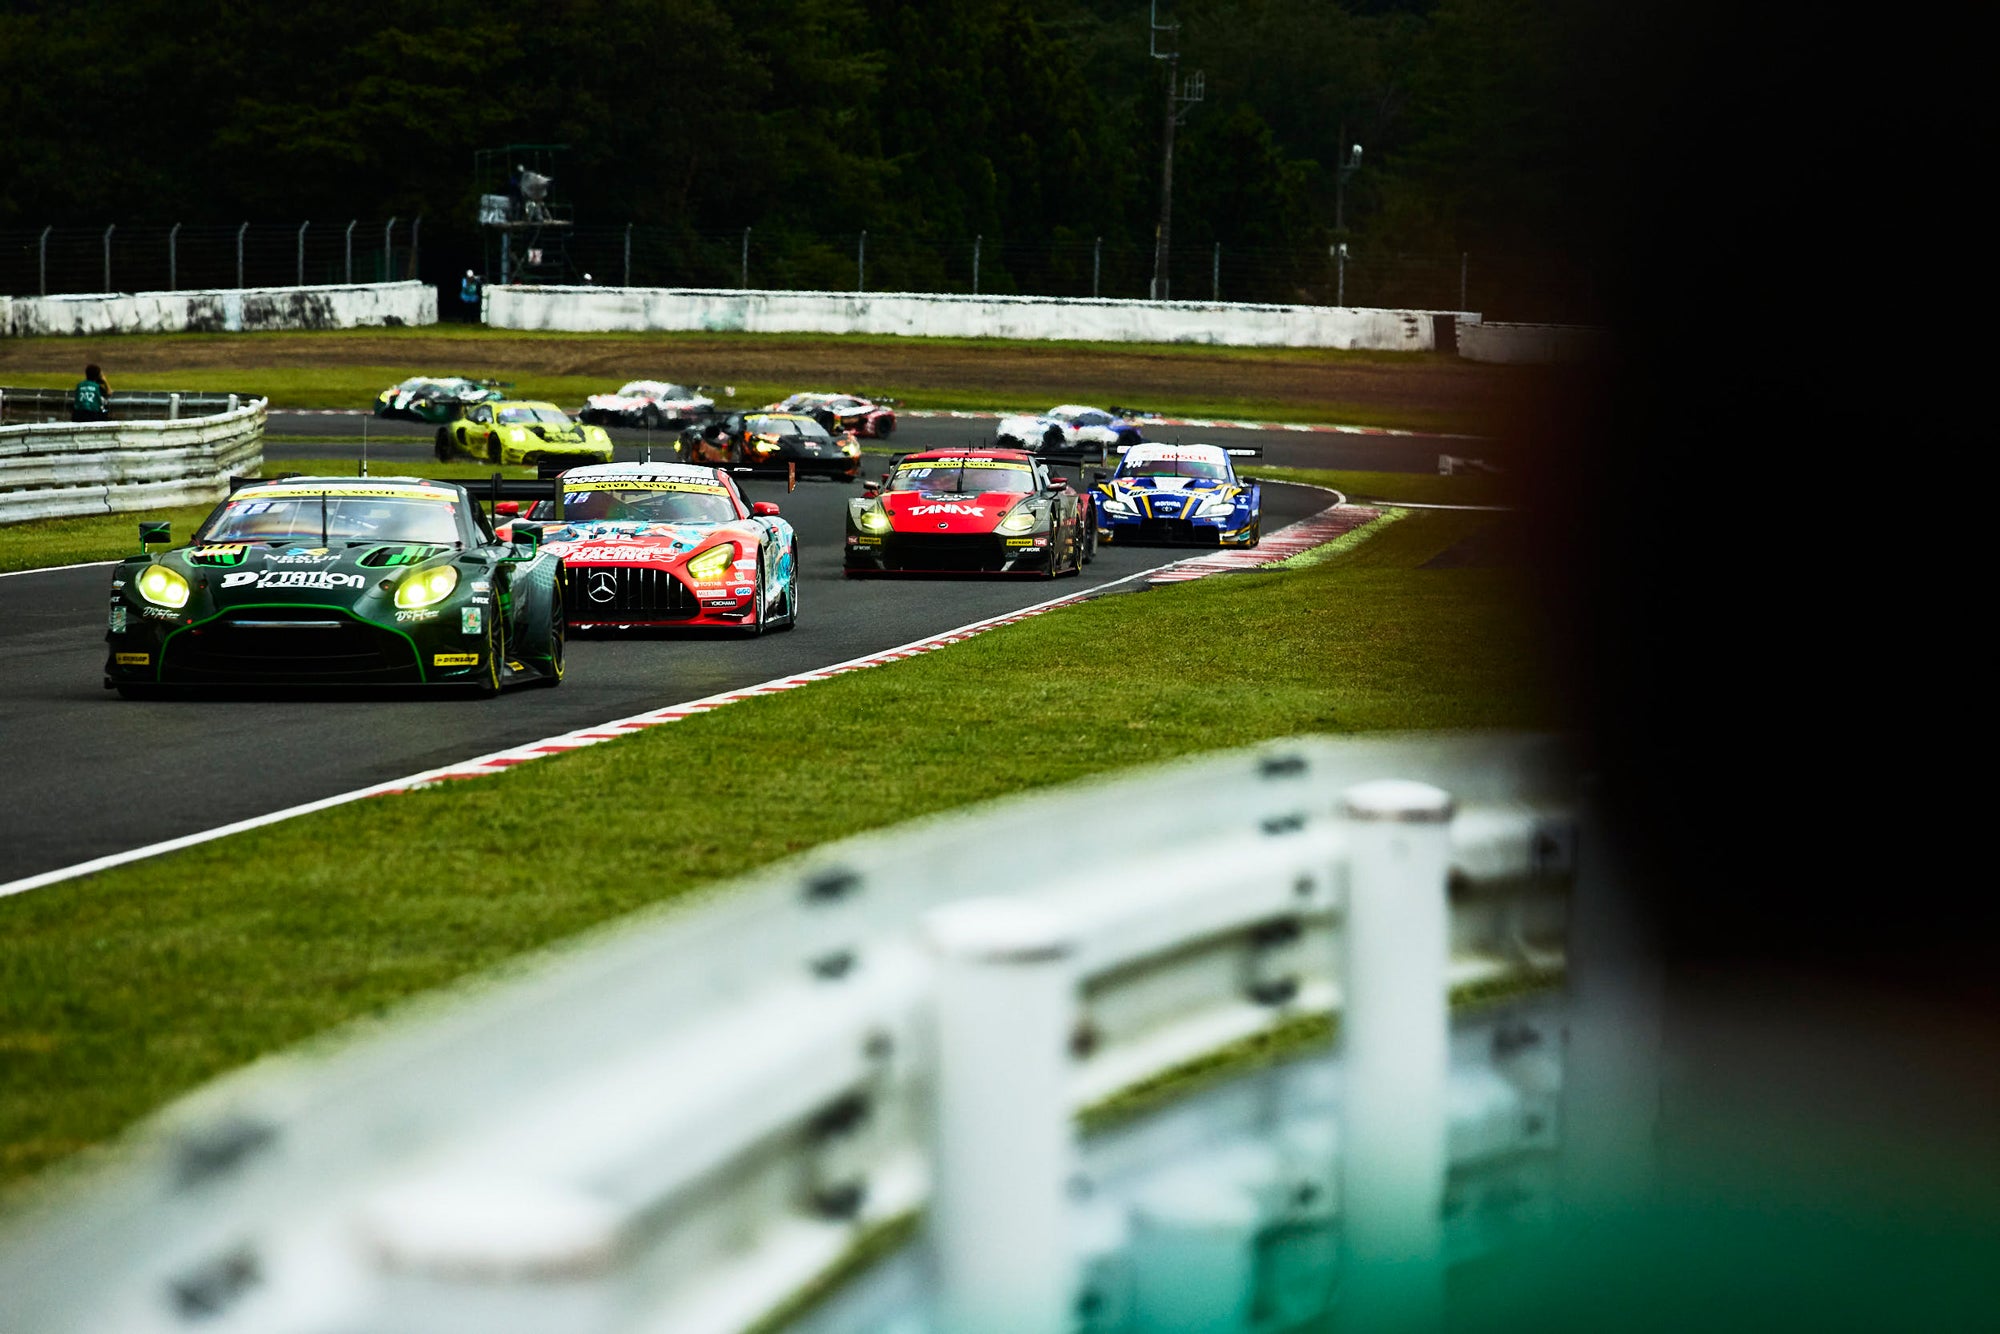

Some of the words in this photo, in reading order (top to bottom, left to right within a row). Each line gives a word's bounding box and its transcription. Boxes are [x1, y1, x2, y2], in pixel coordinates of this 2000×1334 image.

[655, 476, 719, 486] RACING
[908, 504, 984, 517] TANAX
[571, 551, 652, 561] RACING
